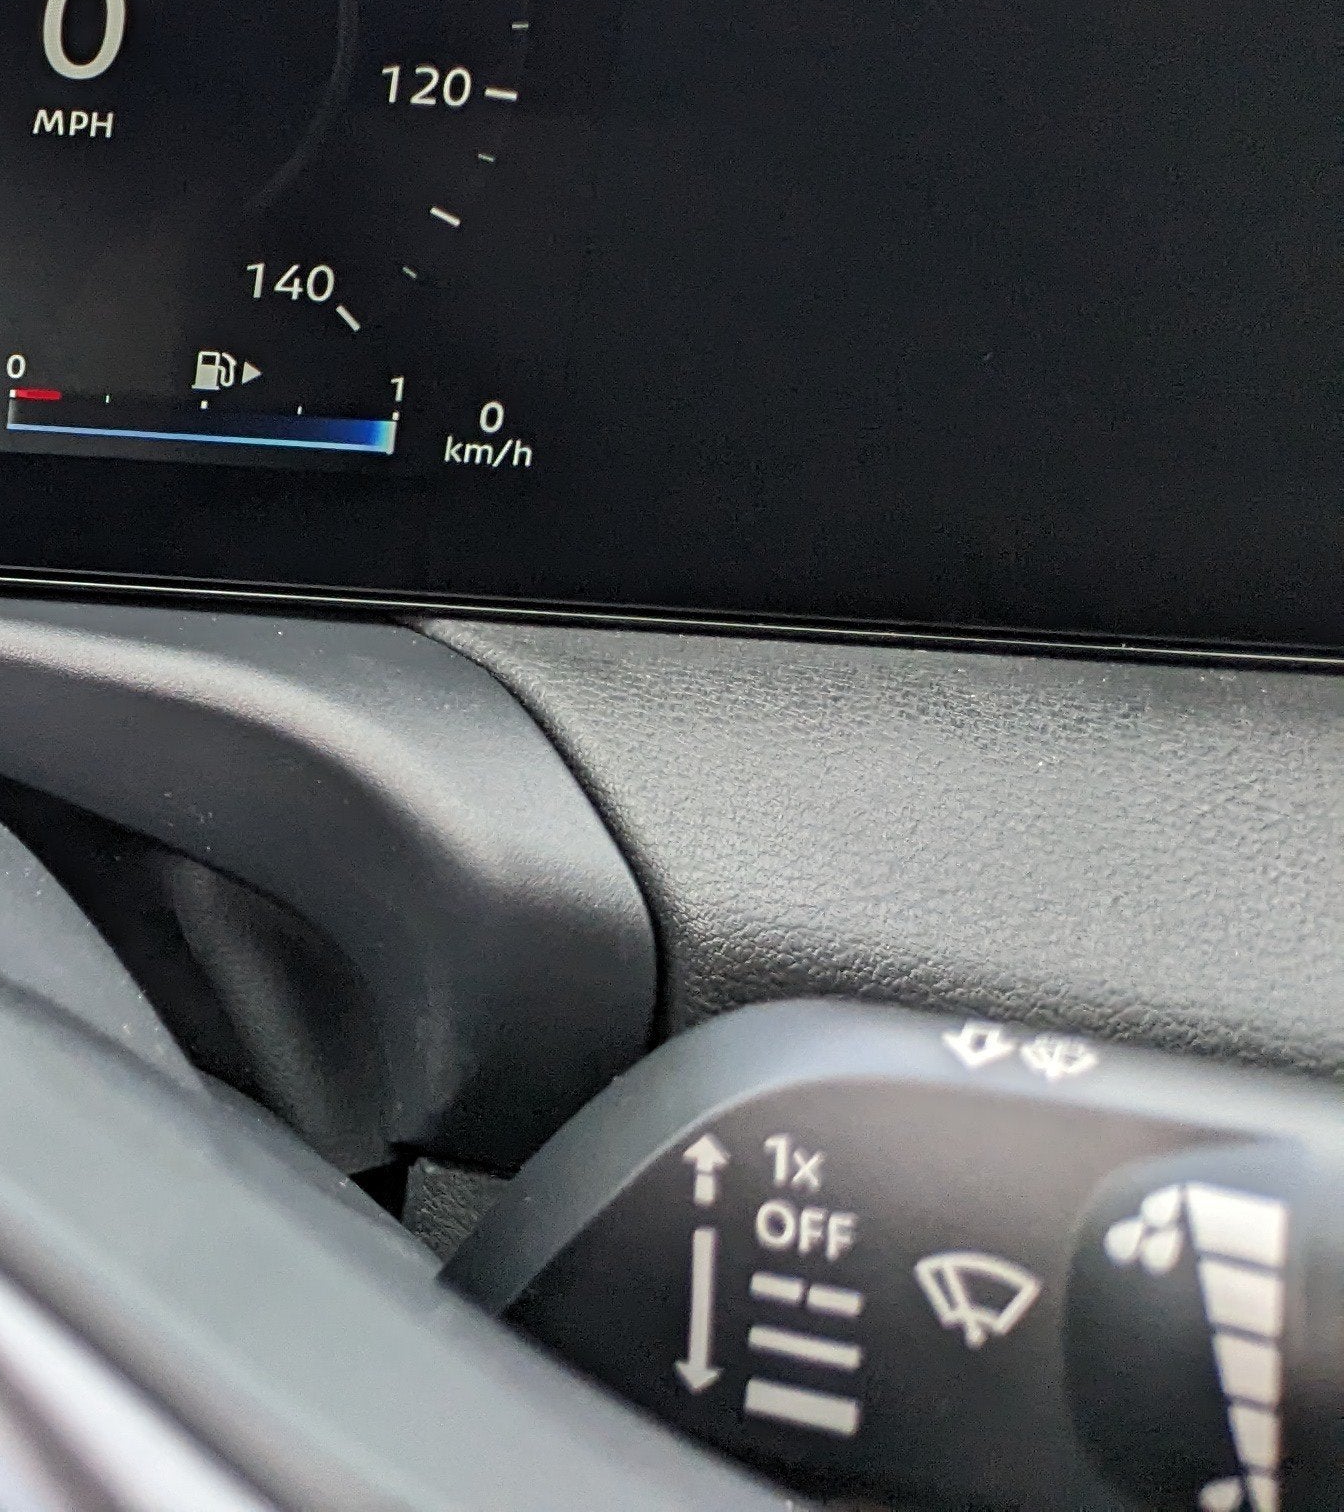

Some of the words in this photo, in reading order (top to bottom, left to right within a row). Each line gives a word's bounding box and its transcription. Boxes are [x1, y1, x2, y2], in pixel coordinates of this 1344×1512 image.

[379, 65, 472, 107] 120
[31, 108, 116, 140] MPH
[247, 262, 336, 303] 140
[8, 354, 27, 379] 0
[391, 374, 407, 403] 1
[481, 402, 506, 435] 0
[445, 438, 534, 469] km/h
[763, 1133, 826, 1190] 1x
[755, 1199, 857, 1261] OFF
